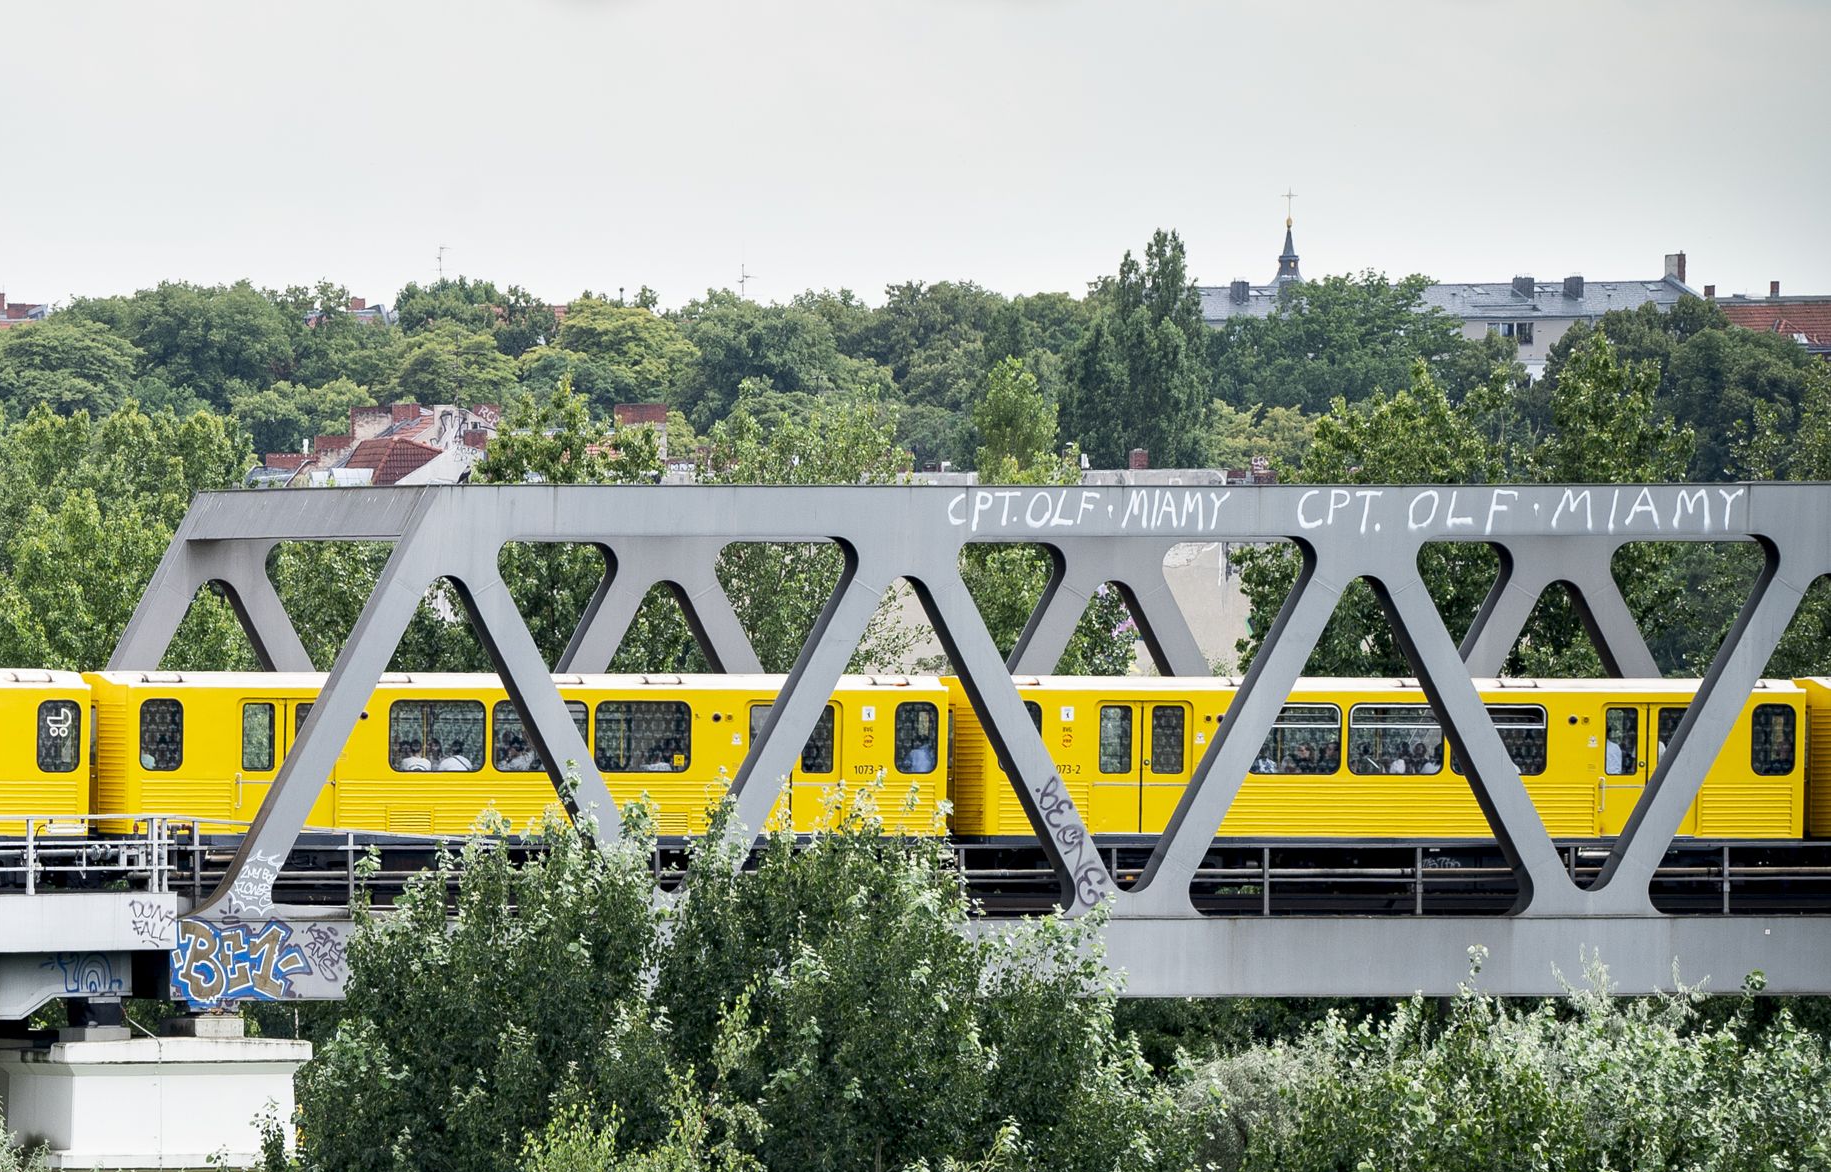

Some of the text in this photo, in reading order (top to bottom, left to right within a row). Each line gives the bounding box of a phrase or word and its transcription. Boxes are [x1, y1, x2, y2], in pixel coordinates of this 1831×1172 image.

[1121, 489, 1231, 531] MIAMY
[1407, 488, 1519, 535] OLF
[1550, 486, 1745, 531] MIAMY
[1056, 764, 1081, 775] 073-2
[131, 919, 171, 942] FALL
